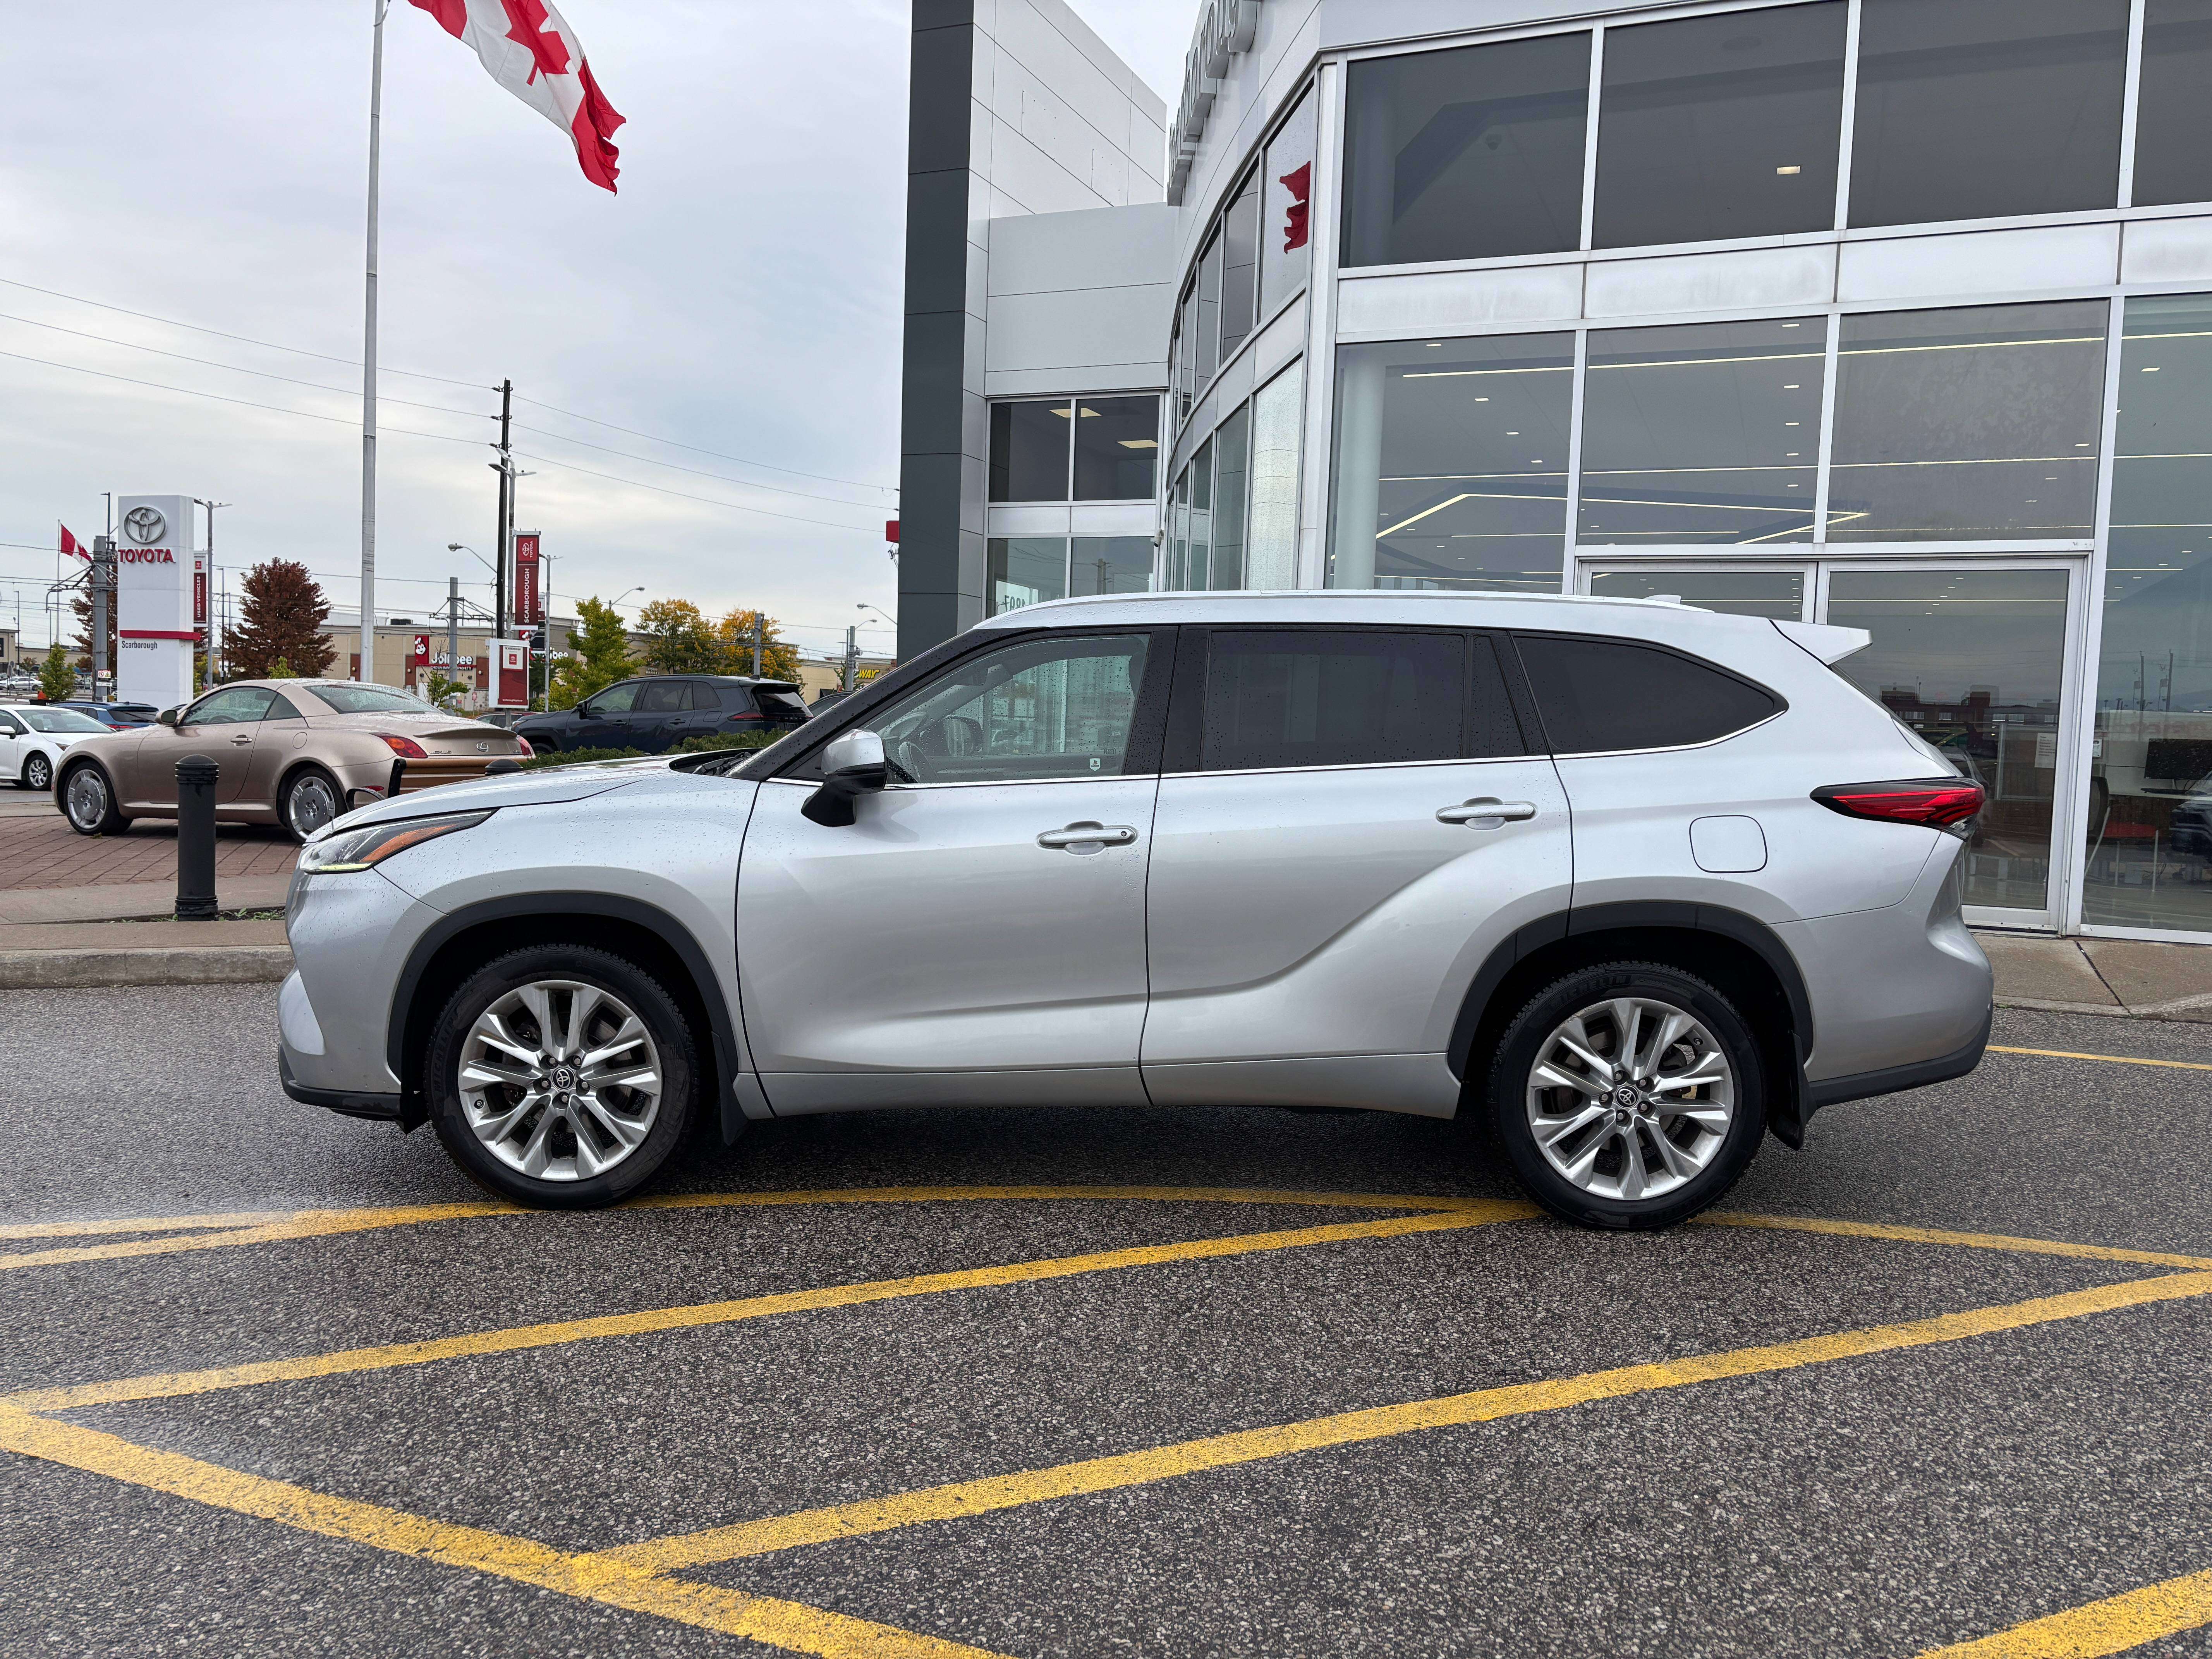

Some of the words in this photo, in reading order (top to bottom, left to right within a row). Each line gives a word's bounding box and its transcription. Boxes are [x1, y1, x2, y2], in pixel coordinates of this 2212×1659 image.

[118, 548, 175, 563] TOYOTA
[122, 640, 158, 650] Scarborough
[431, 652, 473, 665] Jollee
